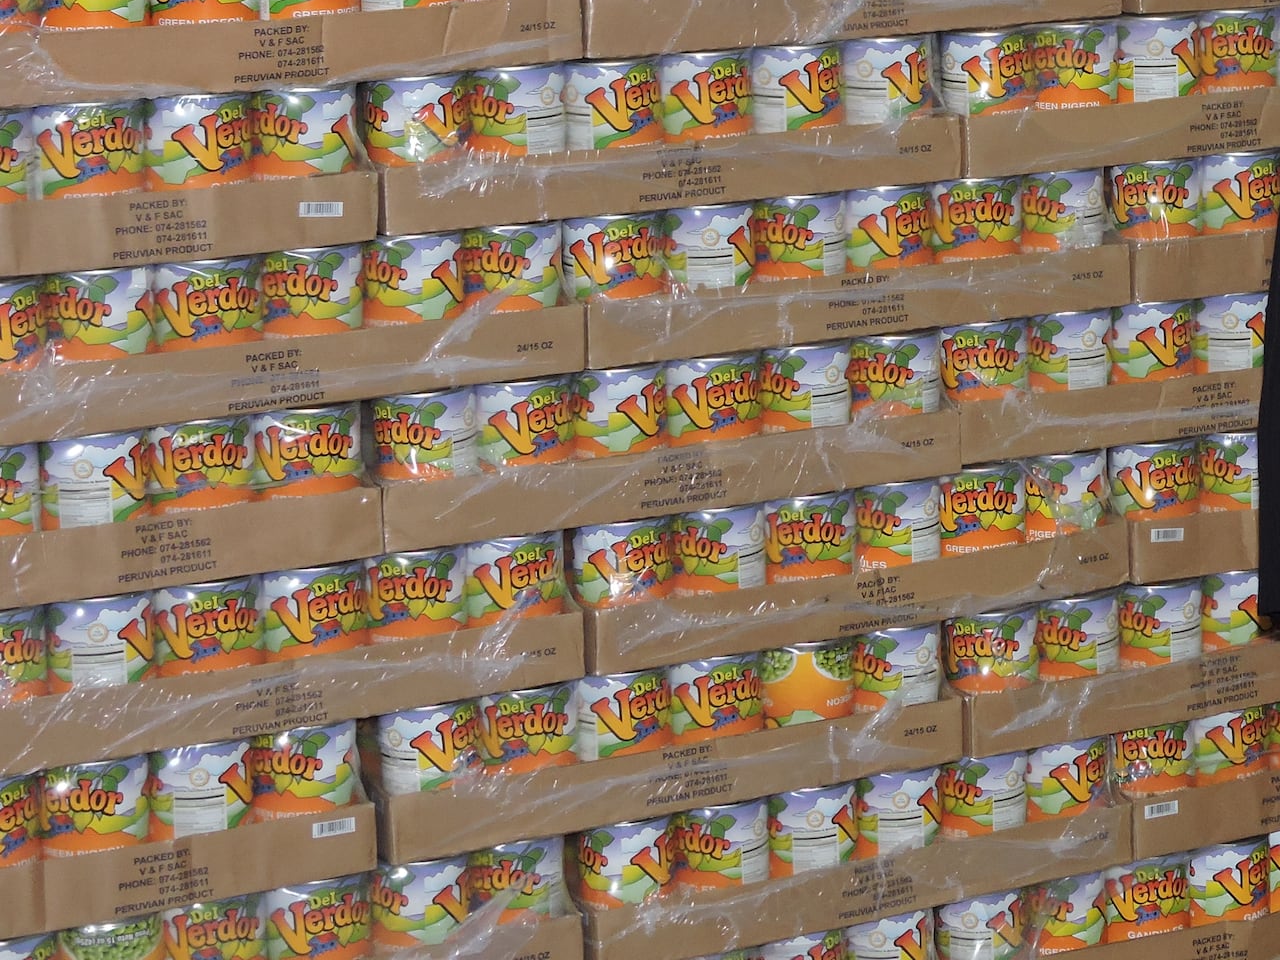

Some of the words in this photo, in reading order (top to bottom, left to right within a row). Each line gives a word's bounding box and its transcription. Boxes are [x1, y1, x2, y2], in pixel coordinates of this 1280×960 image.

[254, 27, 291, 37] PACKED
[294, 25, 309, 34] BY:
[520, 23, 541, 32] 24/15
[543, 21, 556, 30] OZ
[1216, 22, 1240, 36] Del
[238, 50, 274, 60] PHONE:
[278, 45, 324, 57] 074-281562
[278, 56, 324, 68] 074-281611
[234, 73, 282, 84] PERUVIAN
[285, 68, 330, 79] PRODUCT
[1187, 142, 1225, 153] PERUVIAN
[1227, 139, 1262, 149] PRODUCT
[1126, 168, 1148, 185] Del
[952, 187, 978, 202] Del
[129, 200, 166, 211] PACKED
[171, 199, 188, 209] BY:
[136, 213, 143, 222] V
[155, 212, 160, 220] F
[163, 210, 183, 220] SAC
[115, 225, 152, 236] PHONE:
[156, 220, 207, 232] 074-281562
[156, 232, 207, 243] 074-281611
[113, 248, 162, 259] PERUVIAN
[166, 244, 213, 255] PRODUCT
[265, 258, 288, 273] Del
[191, 273, 221, 290] Del
[517, 343, 539, 352] 24/15
[541, 341, 553, 349] OZ
[956, 334, 980, 348] Del
[1153, 454, 1177, 469] Del
[956, 477, 978, 492] Del
[780, 509, 803, 524] Del
[136, 522, 173, 532] PACKED
[177, 519, 192, 528] BY:
[121, 547, 157, 558] PHONE:
[160, 539, 211, 552] 074-281562
[514, 547, 541, 563] Del
[160, 550, 212, 563] 074-281611
[119, 570, 168, 583] PERUVIAN
[170, 561, 217, 575] PRODUCT
[381, 563, 407, 577] Del
[313, 579, 340, 598] Del
[190, 597, 219, 613] Del
[500, 699, 526, 715] Del
[904, 728, 924, 737] 24/15
[926, 725, 937, 734] OZ
[134, 852, 173, 865] PACKED
[176, 849, 191, 858] BY:
[1136, 866, 1160, 882] Del
[115, 900, 165, 914] PERUVIAN
[168, 889, 214, 904] PRODUCT
[309, 891, 337, 908] Del
[190, 906, 219, 923] Del
